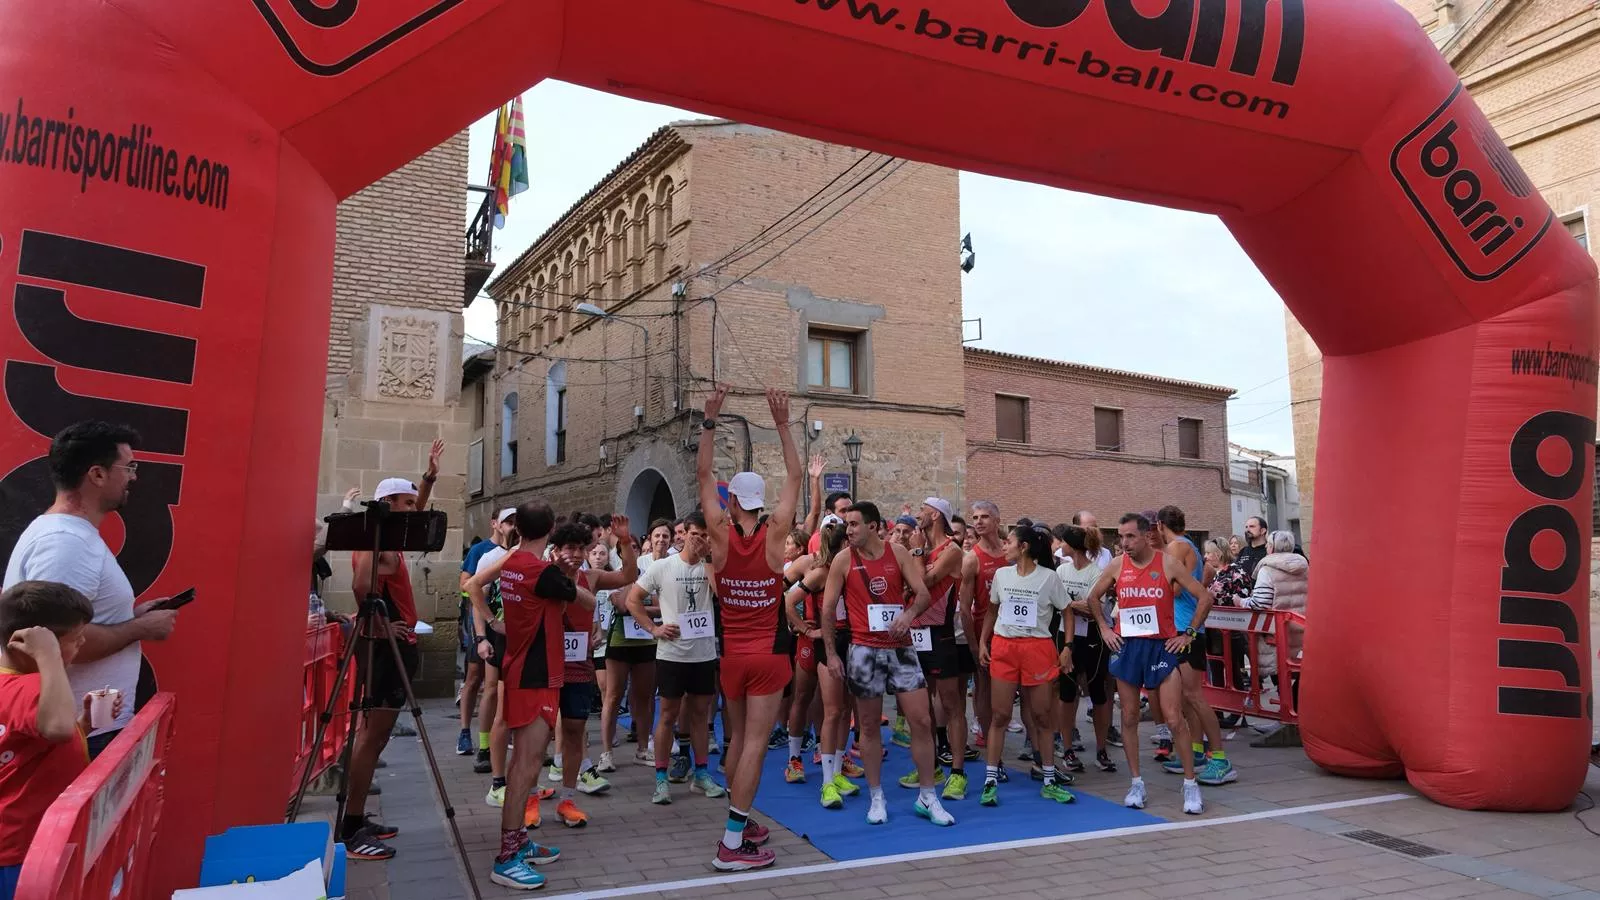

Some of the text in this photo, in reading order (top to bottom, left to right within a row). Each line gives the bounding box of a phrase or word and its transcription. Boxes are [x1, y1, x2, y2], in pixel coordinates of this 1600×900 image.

[1420, 119, 1524, 257] barri
[1497, 410, 1597, 720] barri
[720, 577, 776, 588] ATLETISMO
[730, 589, 767, 598] POMEZ
[881, 611, 895, 621] 87
[1013, 605, 1028, 616] 86
[687, 616, 708, 629] 102
[1129, 612, 1152, 625] 100
[633, 621, 642, 630] 6
[912, 632, 924, 643] 13
